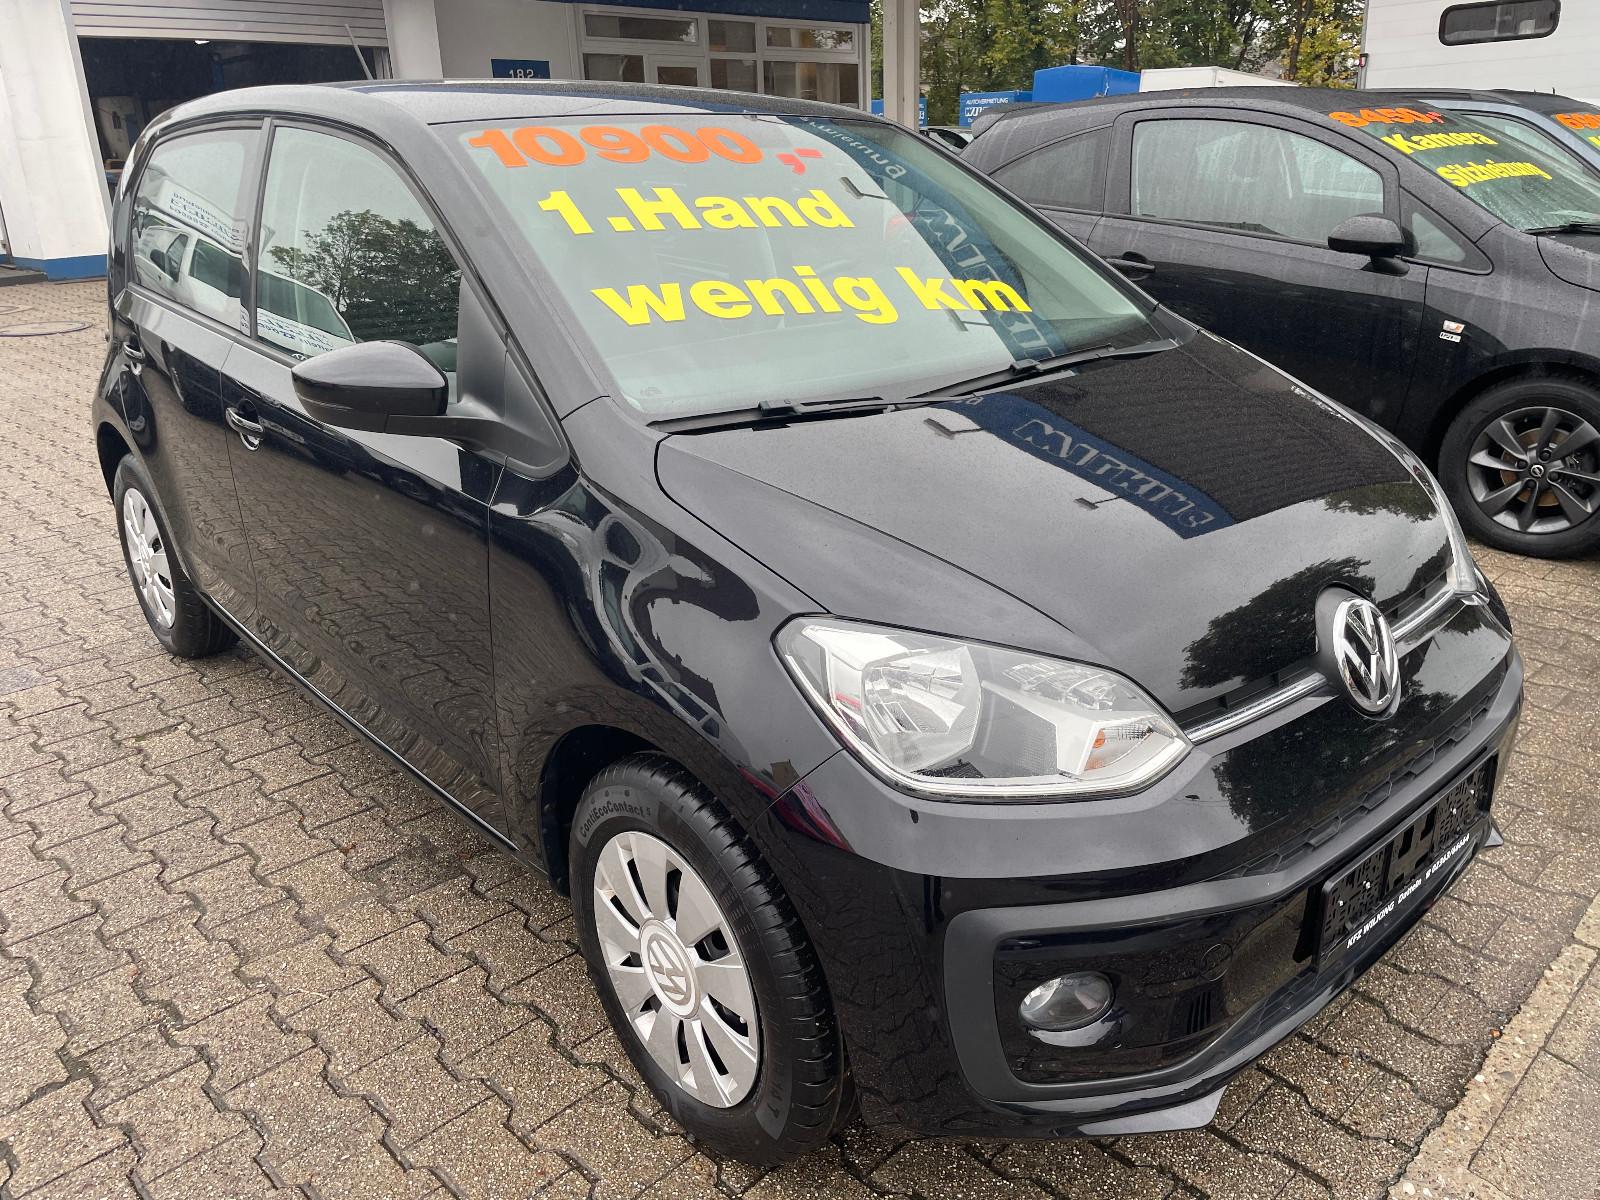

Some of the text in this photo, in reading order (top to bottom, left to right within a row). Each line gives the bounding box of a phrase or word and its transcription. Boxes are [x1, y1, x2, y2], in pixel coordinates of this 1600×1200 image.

[509, 69, 534, 79] 182
[1381, 132, 1498, 155] Kamera
[1436, 159, 1553, 188] Sitzheizung
[537, 187, 856, 236] 1.Hand
[590, 265, 1033, 326] wenig km
[580, 800, 645, 838] ContiEcoContact
[1346, 928, 1363, 949] KFZ
[1363, 901, 1395, 934] WILKING
